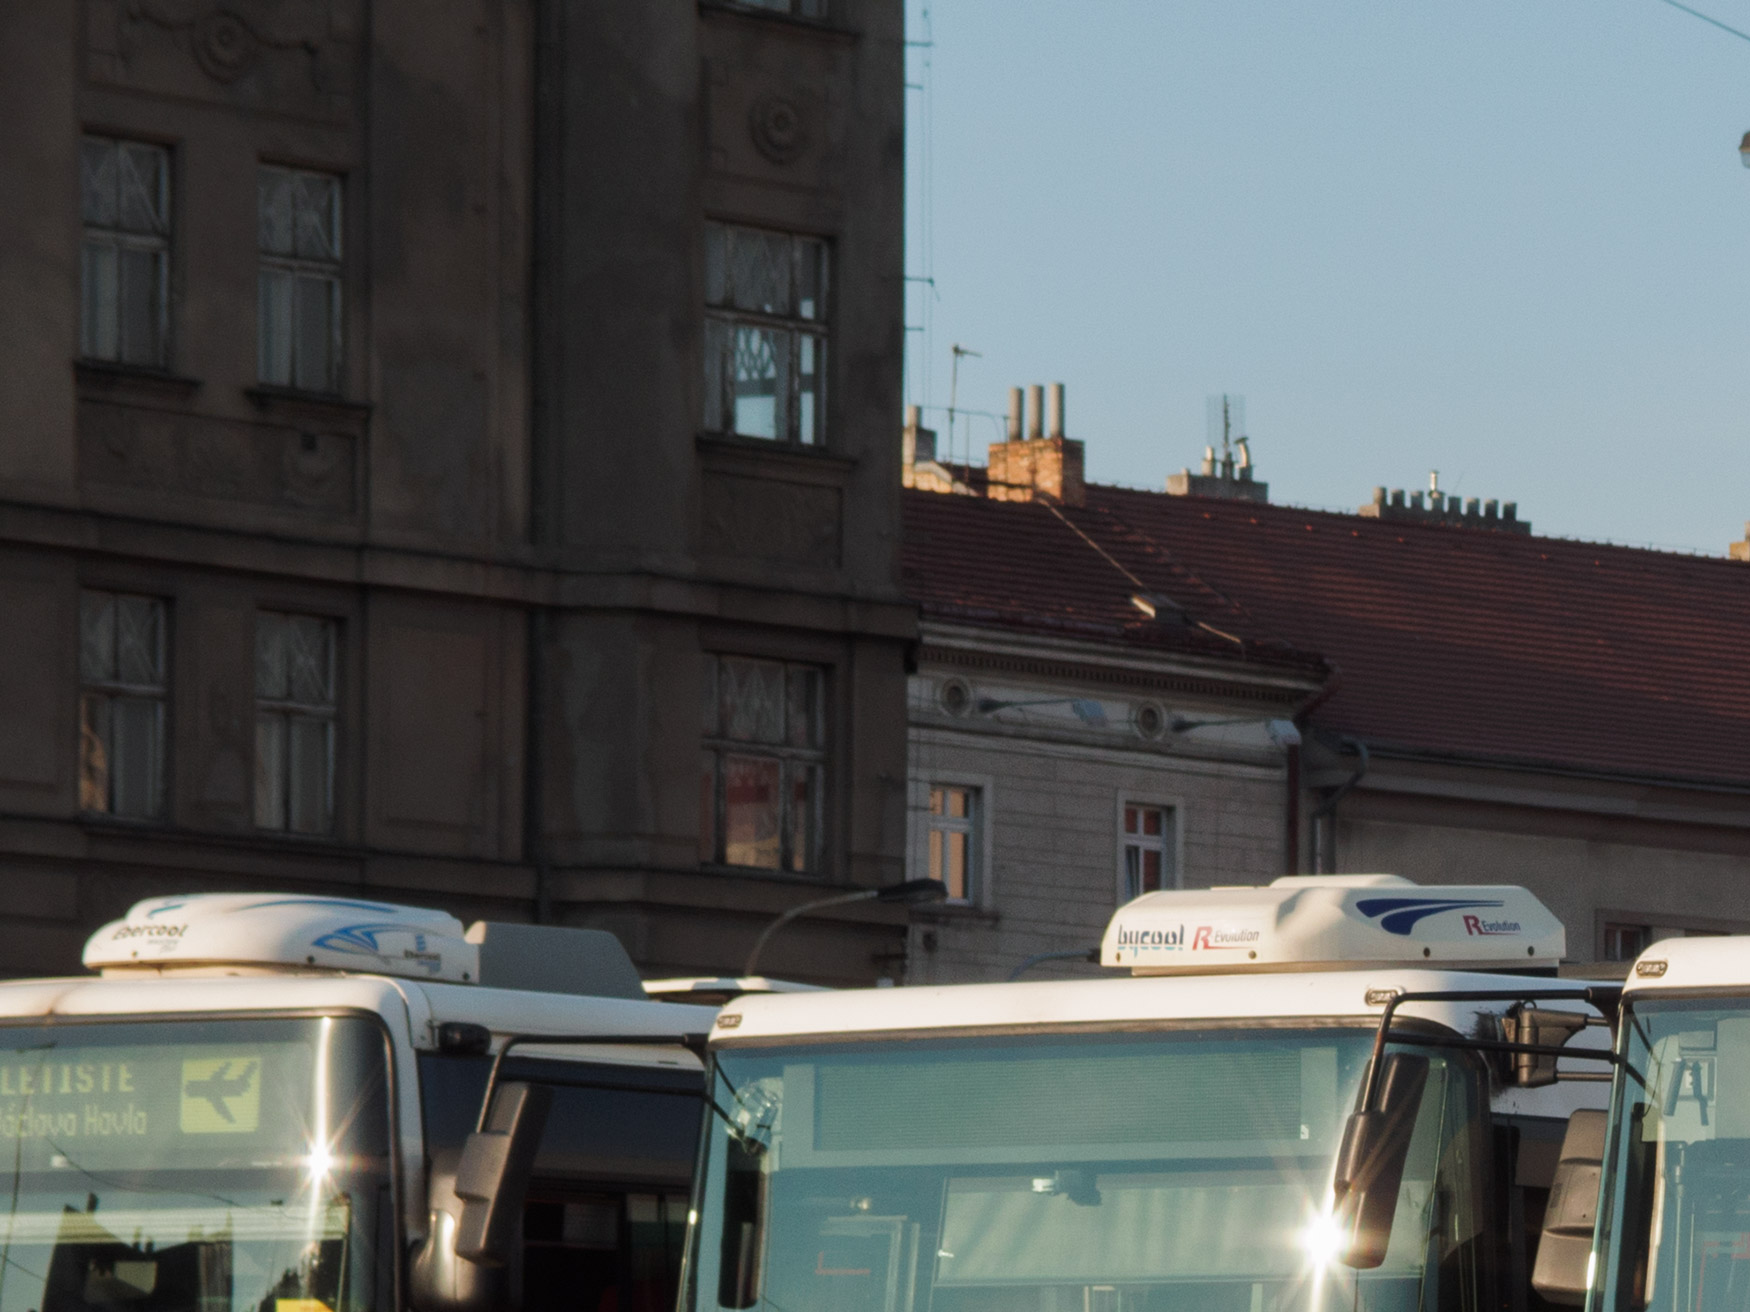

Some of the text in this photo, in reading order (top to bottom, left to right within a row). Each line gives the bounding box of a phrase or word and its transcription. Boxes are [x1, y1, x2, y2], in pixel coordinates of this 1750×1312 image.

[1117, 923, 1185, 958] bycool
[1213, 929, 1260, 943] Evolution
[1481, 920, 1521, 932] Evolution
[84, 1103, 148, 1135] Havla
